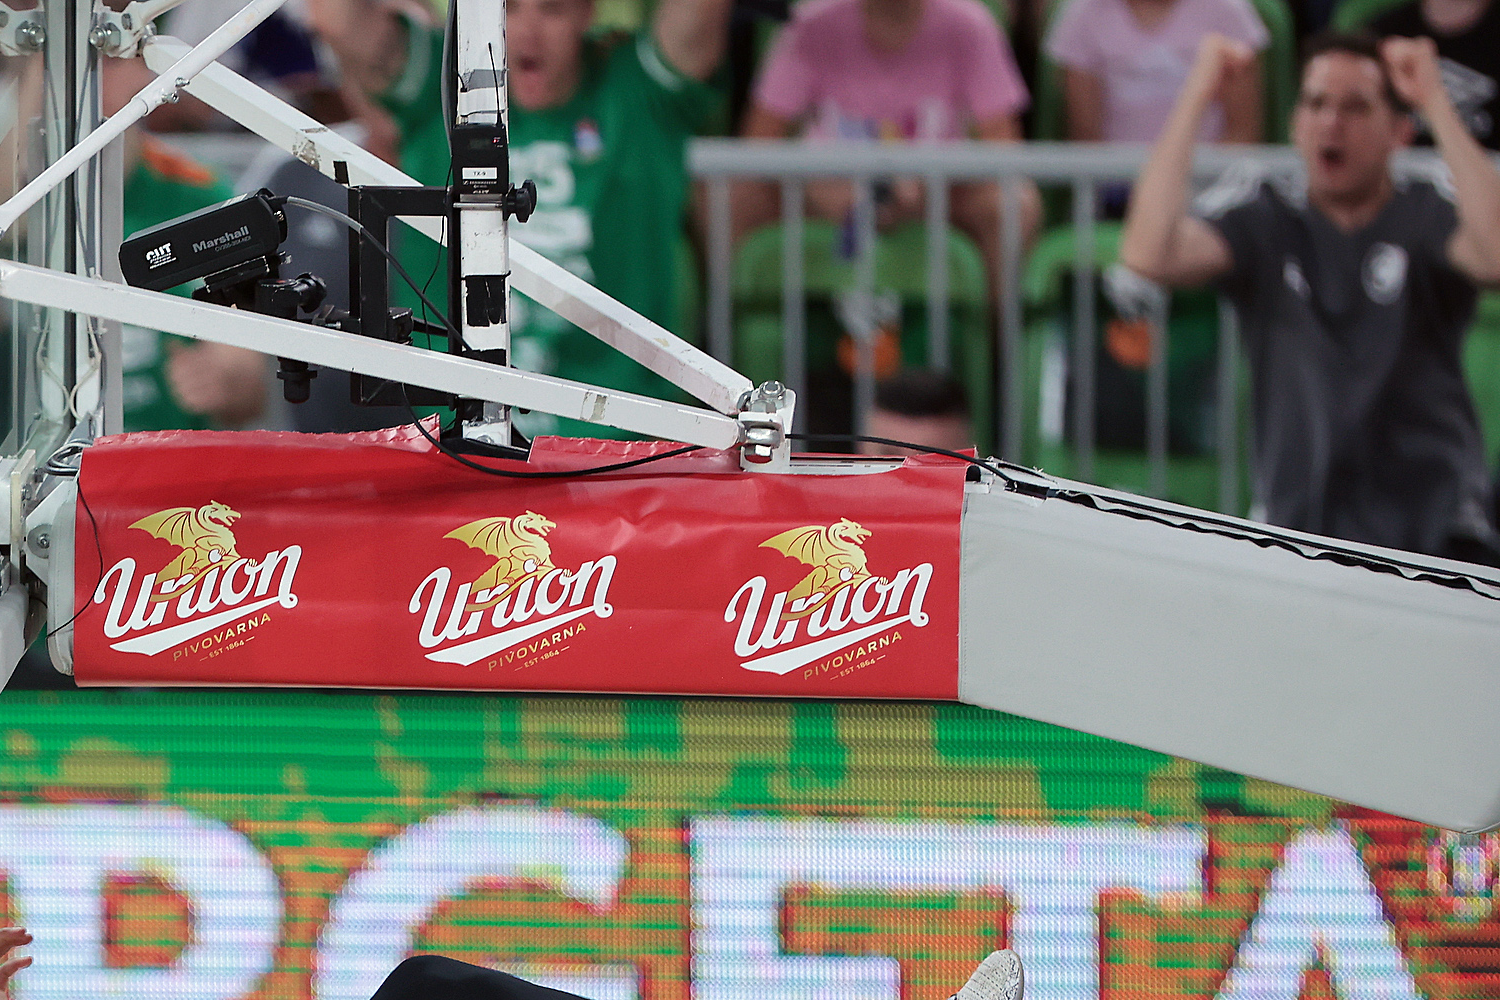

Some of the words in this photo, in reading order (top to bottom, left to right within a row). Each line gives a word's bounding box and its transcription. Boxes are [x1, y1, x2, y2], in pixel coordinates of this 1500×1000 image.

[192, 225, 250, 253] Marshall
[93, 544, 303, 640] Union
[408, 555, 618, 648] Union
[723, 562, 934, 658] Union
[172, 612, 272, 661] PIVOVARNA
[209, 647, 224, 658] EST
[225, 638, 245, 651] 1864
[488, 622, 587, 671] PIVOVARNA
[524, 658, 539, 668] EST
[540, 649, 560, 661] 1864
[803, 631, 903, 680] PIVOVARNA
[840, 667, 855, 677] EST
[856, 658, 876, 670] 1864
